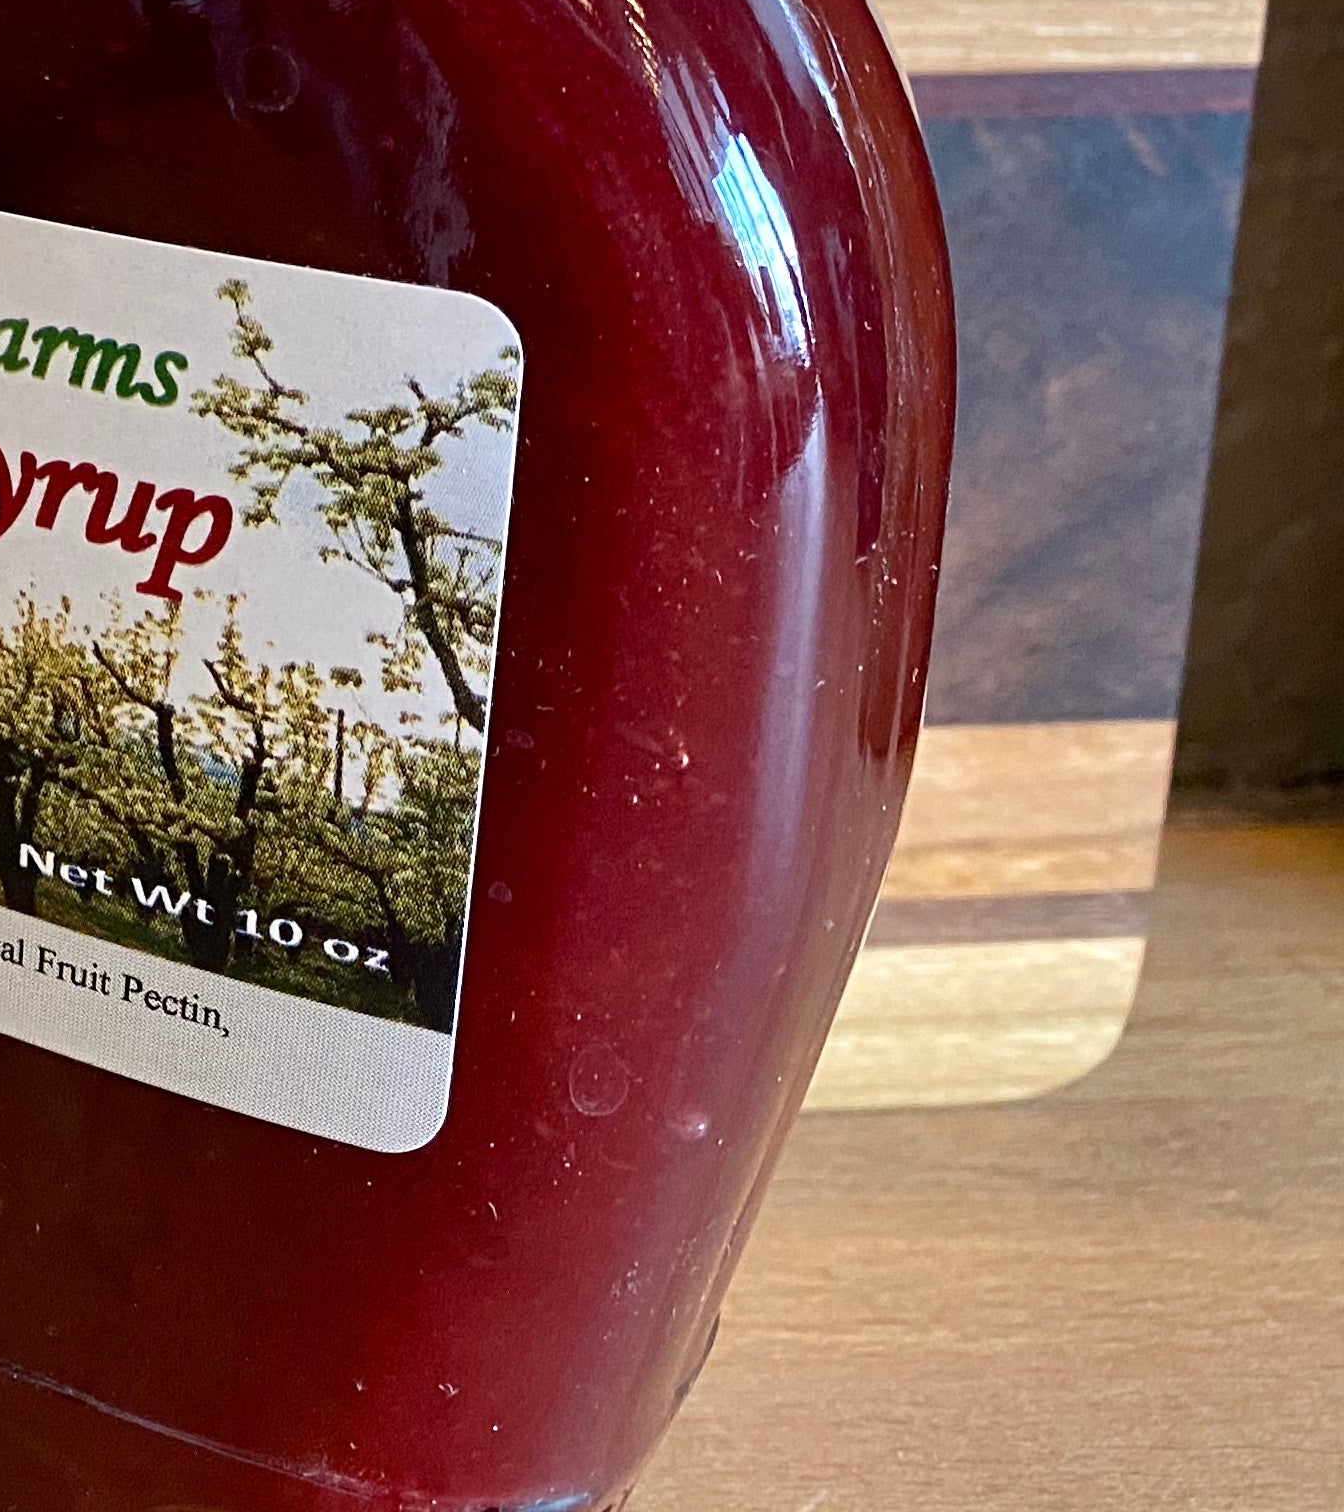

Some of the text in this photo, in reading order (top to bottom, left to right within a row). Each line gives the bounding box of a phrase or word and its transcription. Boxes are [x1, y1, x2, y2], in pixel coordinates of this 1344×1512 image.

[19, 843, 392, 973] Net Wt 10 oz
[37, 946, 111, 995] Fruit
[123, 974, 231, 1037] Pectin,
